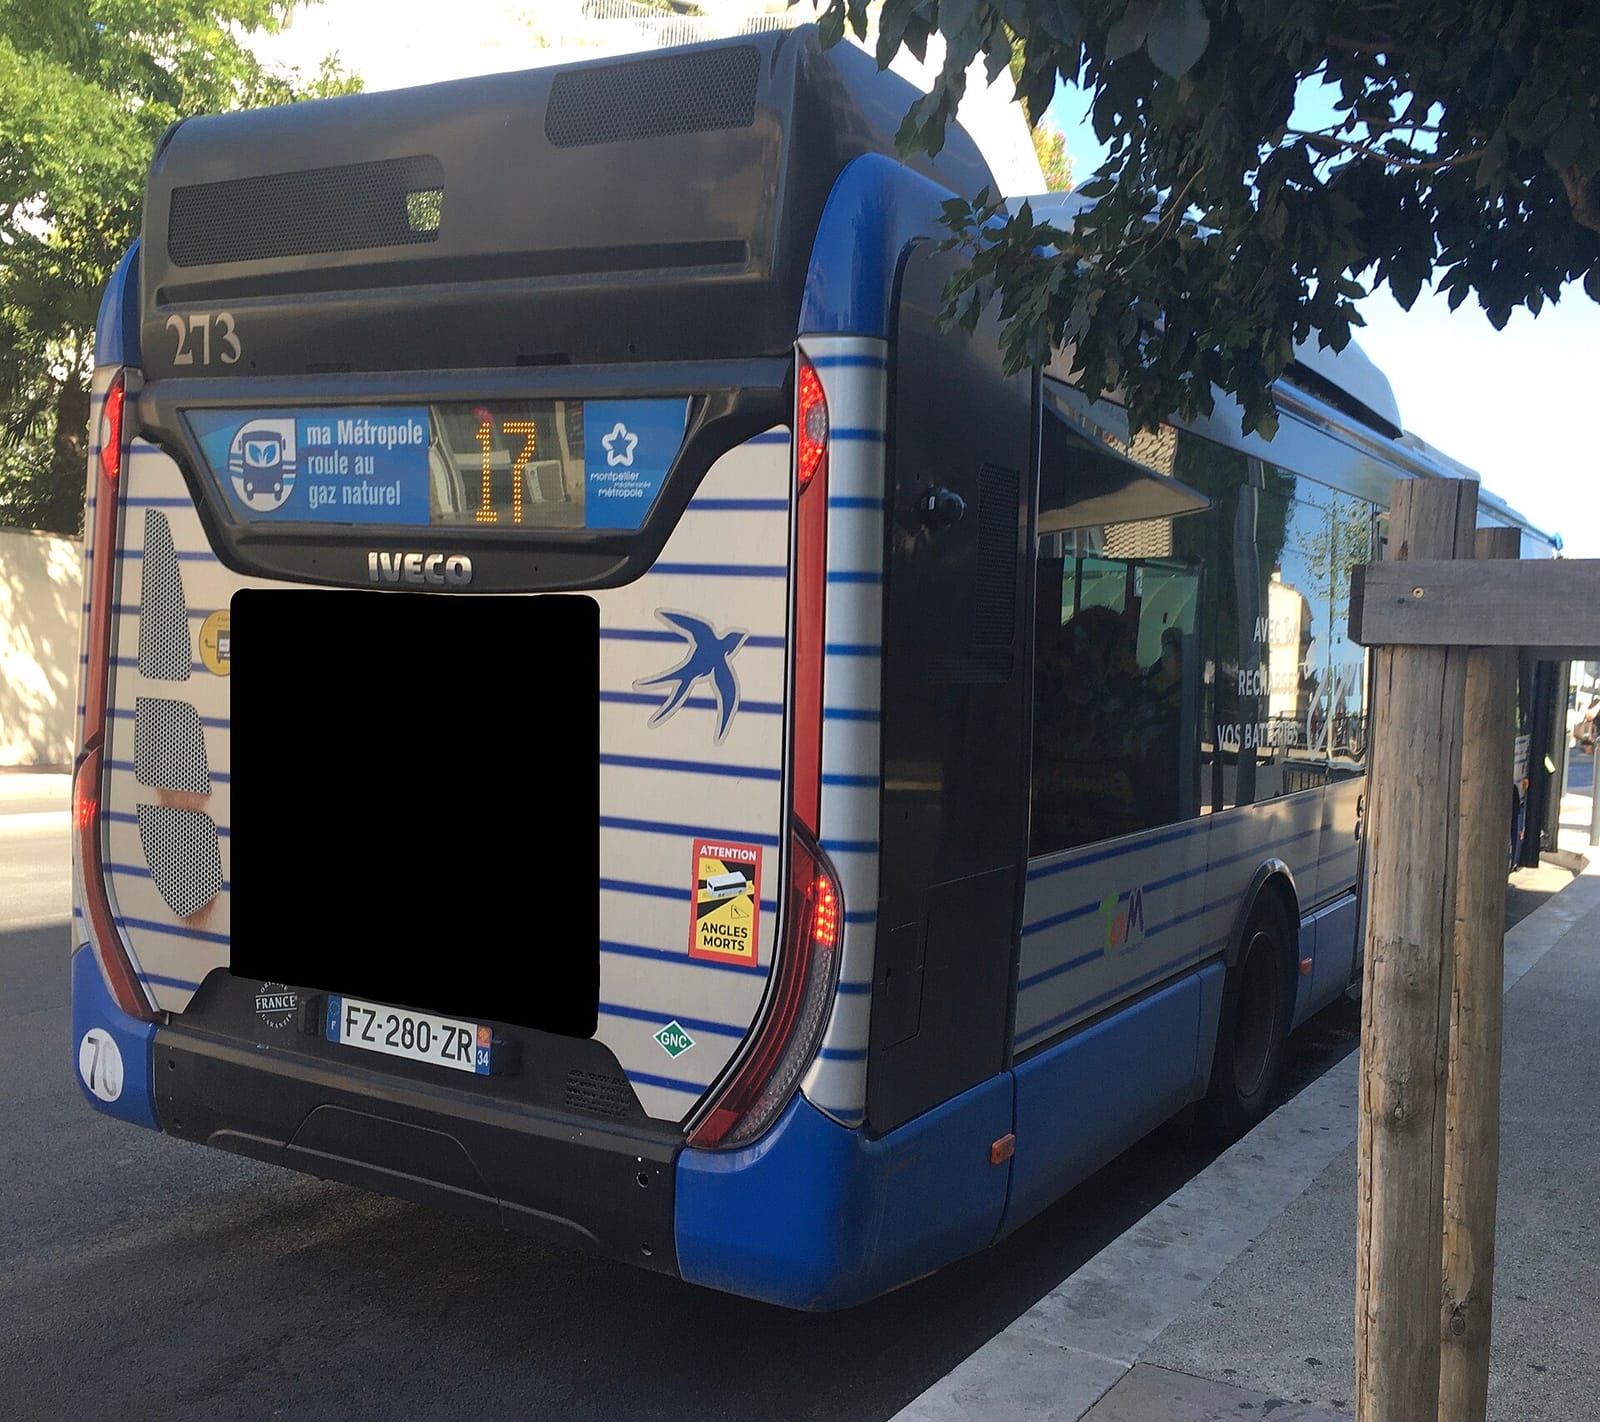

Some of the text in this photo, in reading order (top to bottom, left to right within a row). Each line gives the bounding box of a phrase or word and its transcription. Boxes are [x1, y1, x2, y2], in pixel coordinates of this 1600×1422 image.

[165, 311, 241, 365] 273
[306, 419, 422, 450] ma Métropole
[307, 449, 375, 475] roule au
[475, 421, 535, 523] 17
[590, 470, 640, 482] montpellier
[308, 480, 400, 508] gaz naturel
[598, 487, 643, 499] métropole
[368, 551, 472, 584] IVECO
[1217, 722, 1241, 752] VOS
[699, 844, 757, 861] ATTENTION
[701, 921, 748, 939] ANGLES
[703, 935, 745, 951] MORTS
[255, 995, 296, 1010] FRANCE
[346, 1005, 472, 1063] FZ-280-ZR
[477, 1050, 489, 1067] 34
[660, 1031, 688, 1049] GNC
